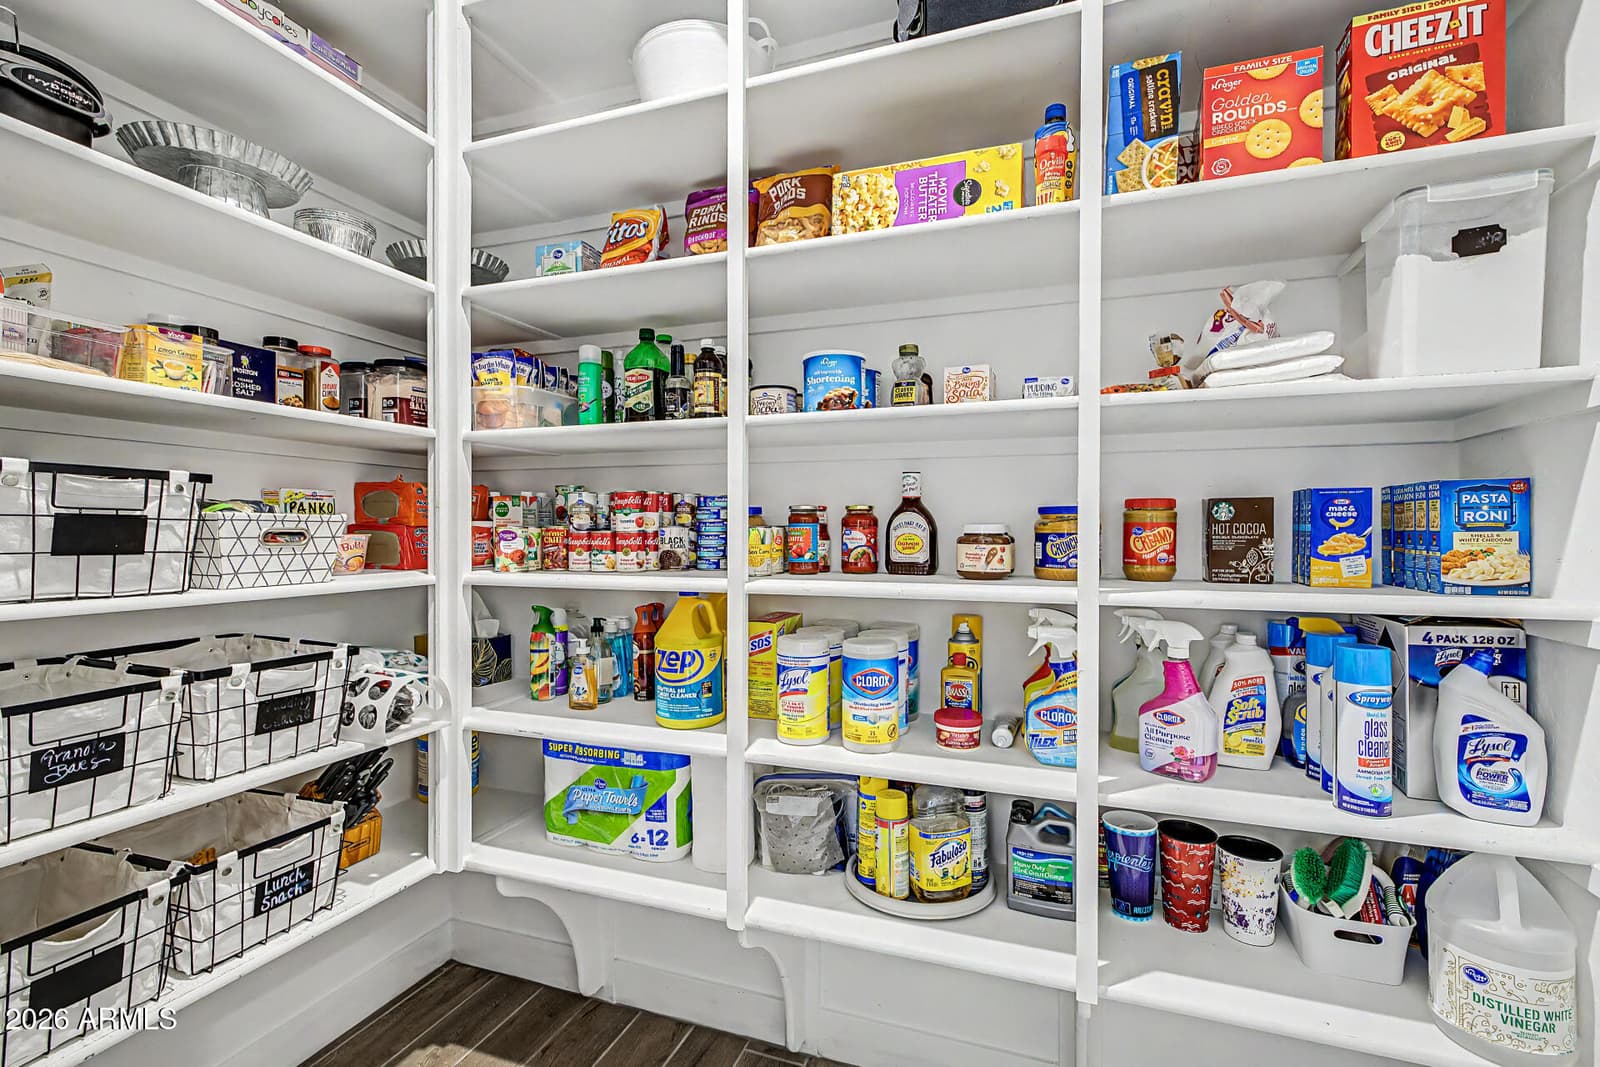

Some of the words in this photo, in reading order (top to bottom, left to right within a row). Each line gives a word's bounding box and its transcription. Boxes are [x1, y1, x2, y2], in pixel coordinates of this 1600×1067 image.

[1368, 9, 1401, 21] FAMILY
[1234, 60, 1268, 73] FAMILY
[1272, 55, 1293, 65] SIZE
[1211, 78, 1243, 92] Kroger
[1211, 92, 1273, 112] Golden
[1212, 100, 1288, 124] ROUNDS
[768, 176, 801, 202] PORK
[928, 170, 938, 222] THEATER
[937, 177, 948, 215] MOVIE
[918, 176, 928, 221] BUTTER
[691, 202, 726, 218] PORK
[688, 212, 727, 228] RINDS
[231, 381, 261, 391] OSHER
[806, 375, 856, 385] Shortening
[235, 388, 255, 397] SALT
[289, 500, 334, 515] PANKO
[1462, 493, 1509, 504] PASTA
[1464, 510, 1508, 522] RONI
[1211, 522, 1231, 535] HOT
[1233, 522, 1267, 535] COCOA
[1050, 535, 1078, 557] CRUNCH
[1134, 527, 1173, 553] CREAMY
[1422, 631, 1433, 645] 4
[1436, 634, 1469, 644] PACK
[1472, 636, 1495, 645] 128
[1497, 636, 1516, 646] OZ
[780, 669, 809, 690] Lysol
[856, 675, 890, 687] CLOROX
[1232, 697, 1260, 711] Soft
[1040, 710, 1078, 724] CLOROX
[1226, 707, 1265, 725] Scrub
[1155, 728, 1191, 741] Purpose
[1364, 718, 1388, 739] glass
[1144, 733, 1174, 745] Cleaner
[1358, 739, 1390, 757] cleane
[1468, 738, 1512, 756] Lysol
[548, 742, 573, 753] SUPER
[574, 744, 620, 760] ABSORBING
[1476, 770, 1509, 781] POWER
[572, 788, 602, 803] Paper
[602, 791, 638, 807] Towels
[929, 840, 968, 868] Fabuloso
[264, 867, 306, 896] Lunch
[1472, 991, 1541, 1021] DISTILLED
[1543, 1008, 1573, 1021] WHITE
[1500, 1013, 1556, 1034] VINEGAR
